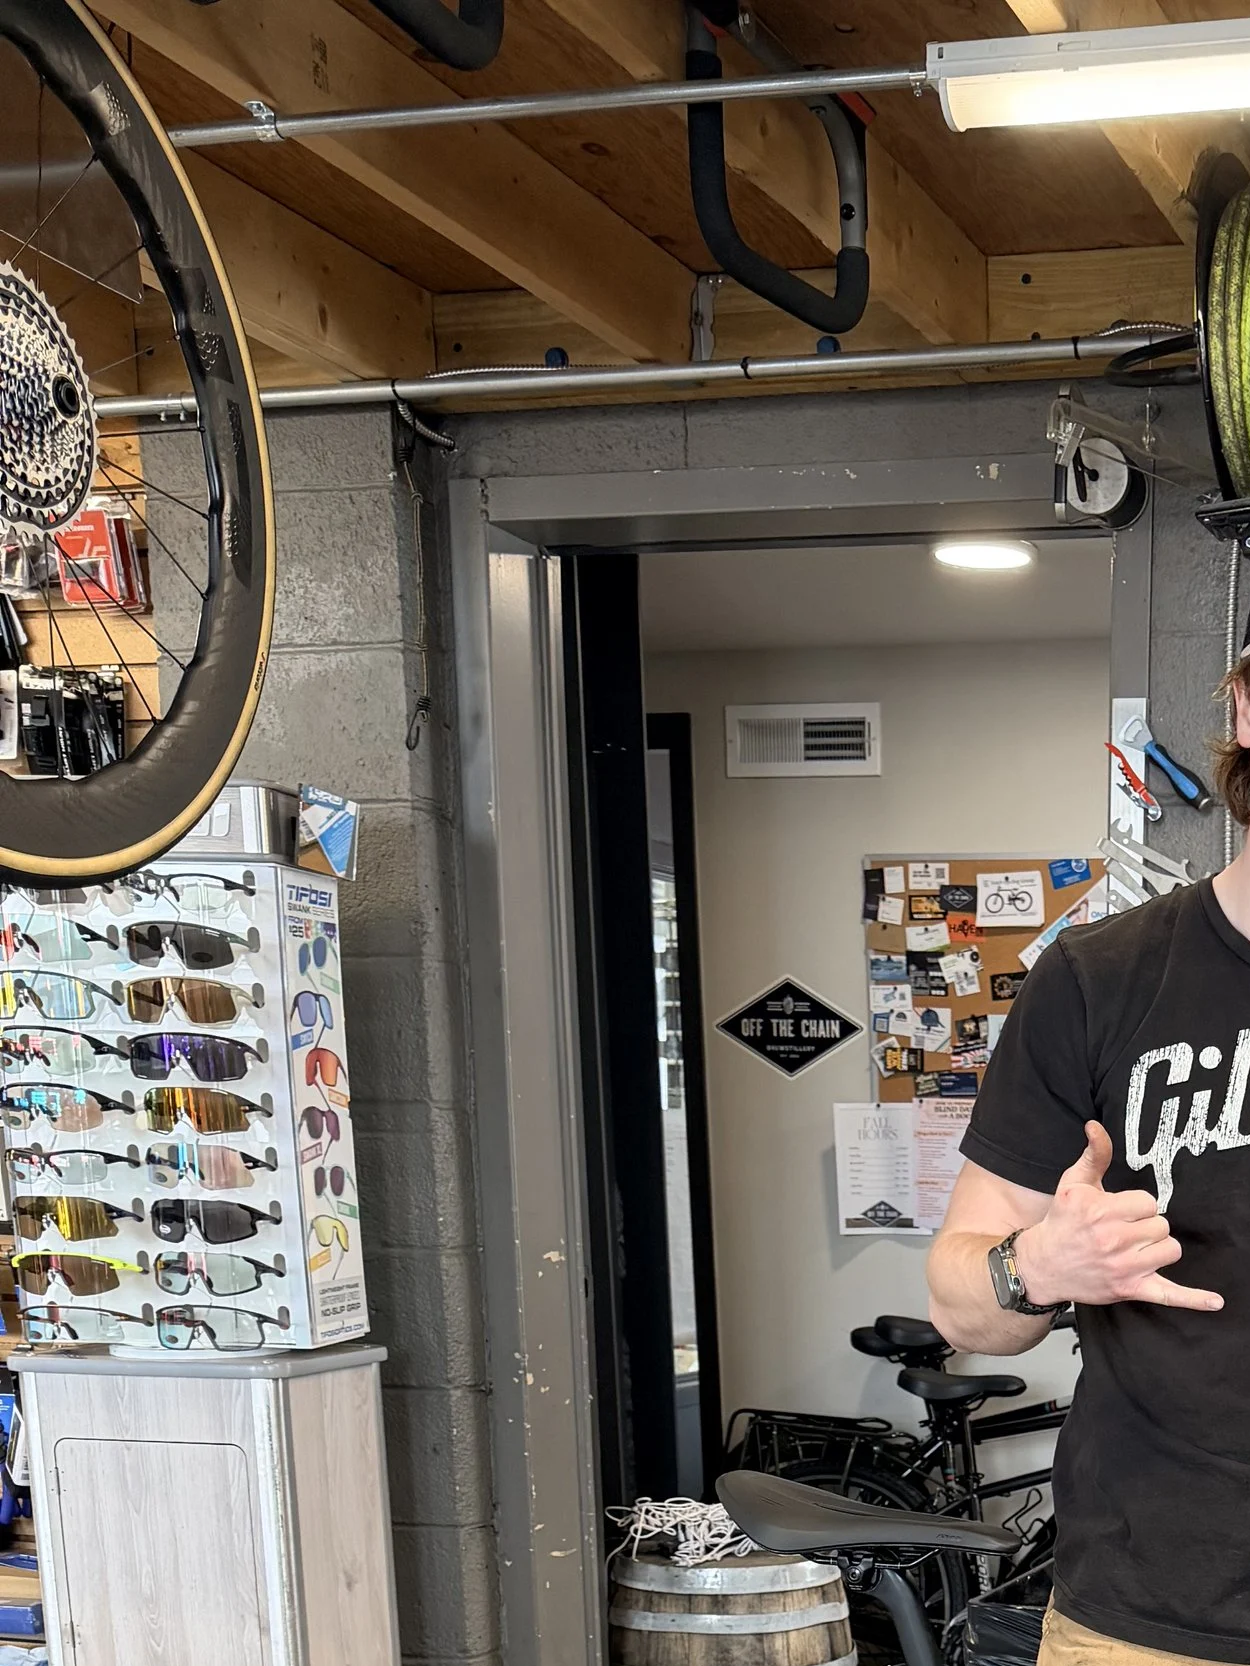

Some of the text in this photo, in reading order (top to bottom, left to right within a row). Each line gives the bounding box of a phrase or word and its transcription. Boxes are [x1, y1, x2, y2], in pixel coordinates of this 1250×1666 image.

[286, 884, 333, 908] TIFOSI
[741, 1018, 841, 1039] OFF THE CHAIN
[934, 1105, 958, 1113] BLIND
[862, 1116, 892, 1129] FALL
[857, 1128, 899, 1141] HOURS
